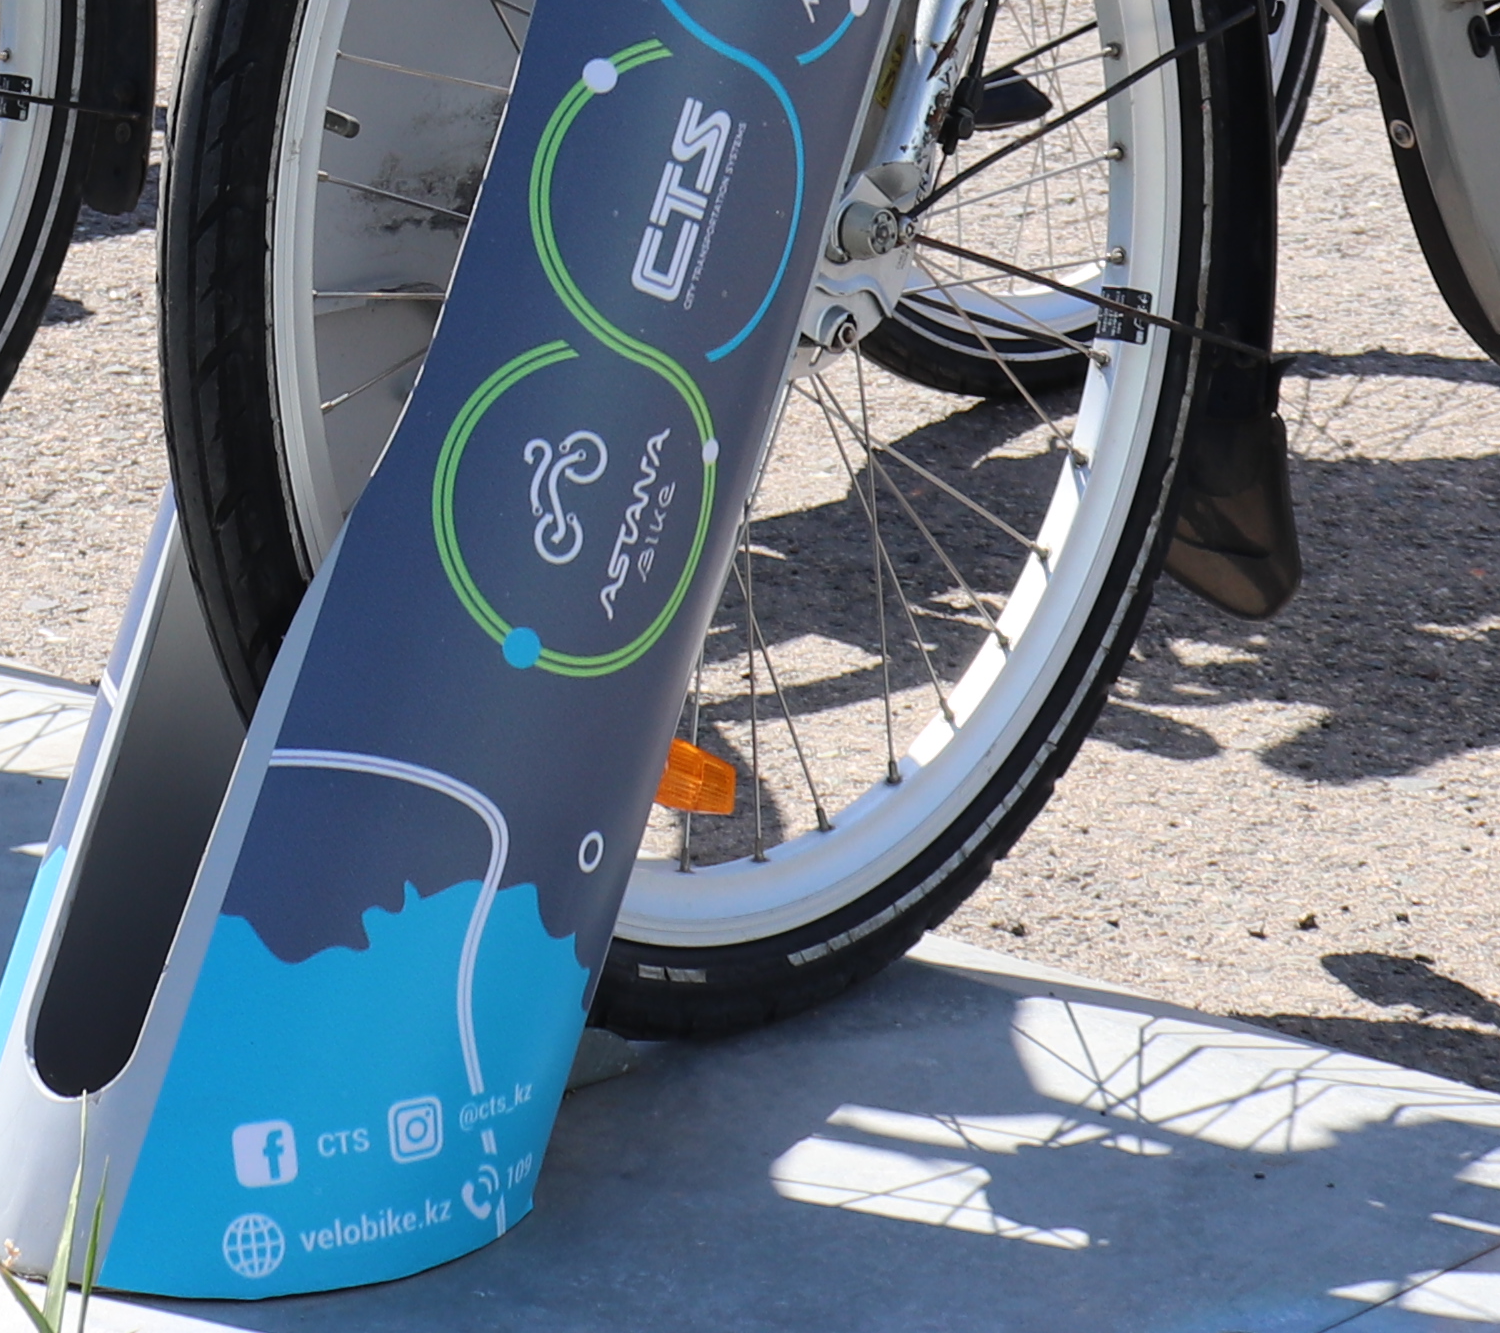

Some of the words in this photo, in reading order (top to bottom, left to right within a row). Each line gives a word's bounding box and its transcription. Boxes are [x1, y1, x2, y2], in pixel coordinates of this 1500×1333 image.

[631, 97, 732, 301] CTS
[683, 284, 698, 310] CITY
[691, 175, 730, 283] TRANSPORTATION
[725, 122, 747, 175] SYSTEMS
[600, 428, 671, 620] ASTANA
[301, 1197, 453, 1253] velobike.kz
[505, 1154, 533, 1191] 109
[317, 1129, 370, 1158] CTS
[459, 1082, 533, 1131] @cts_kz
